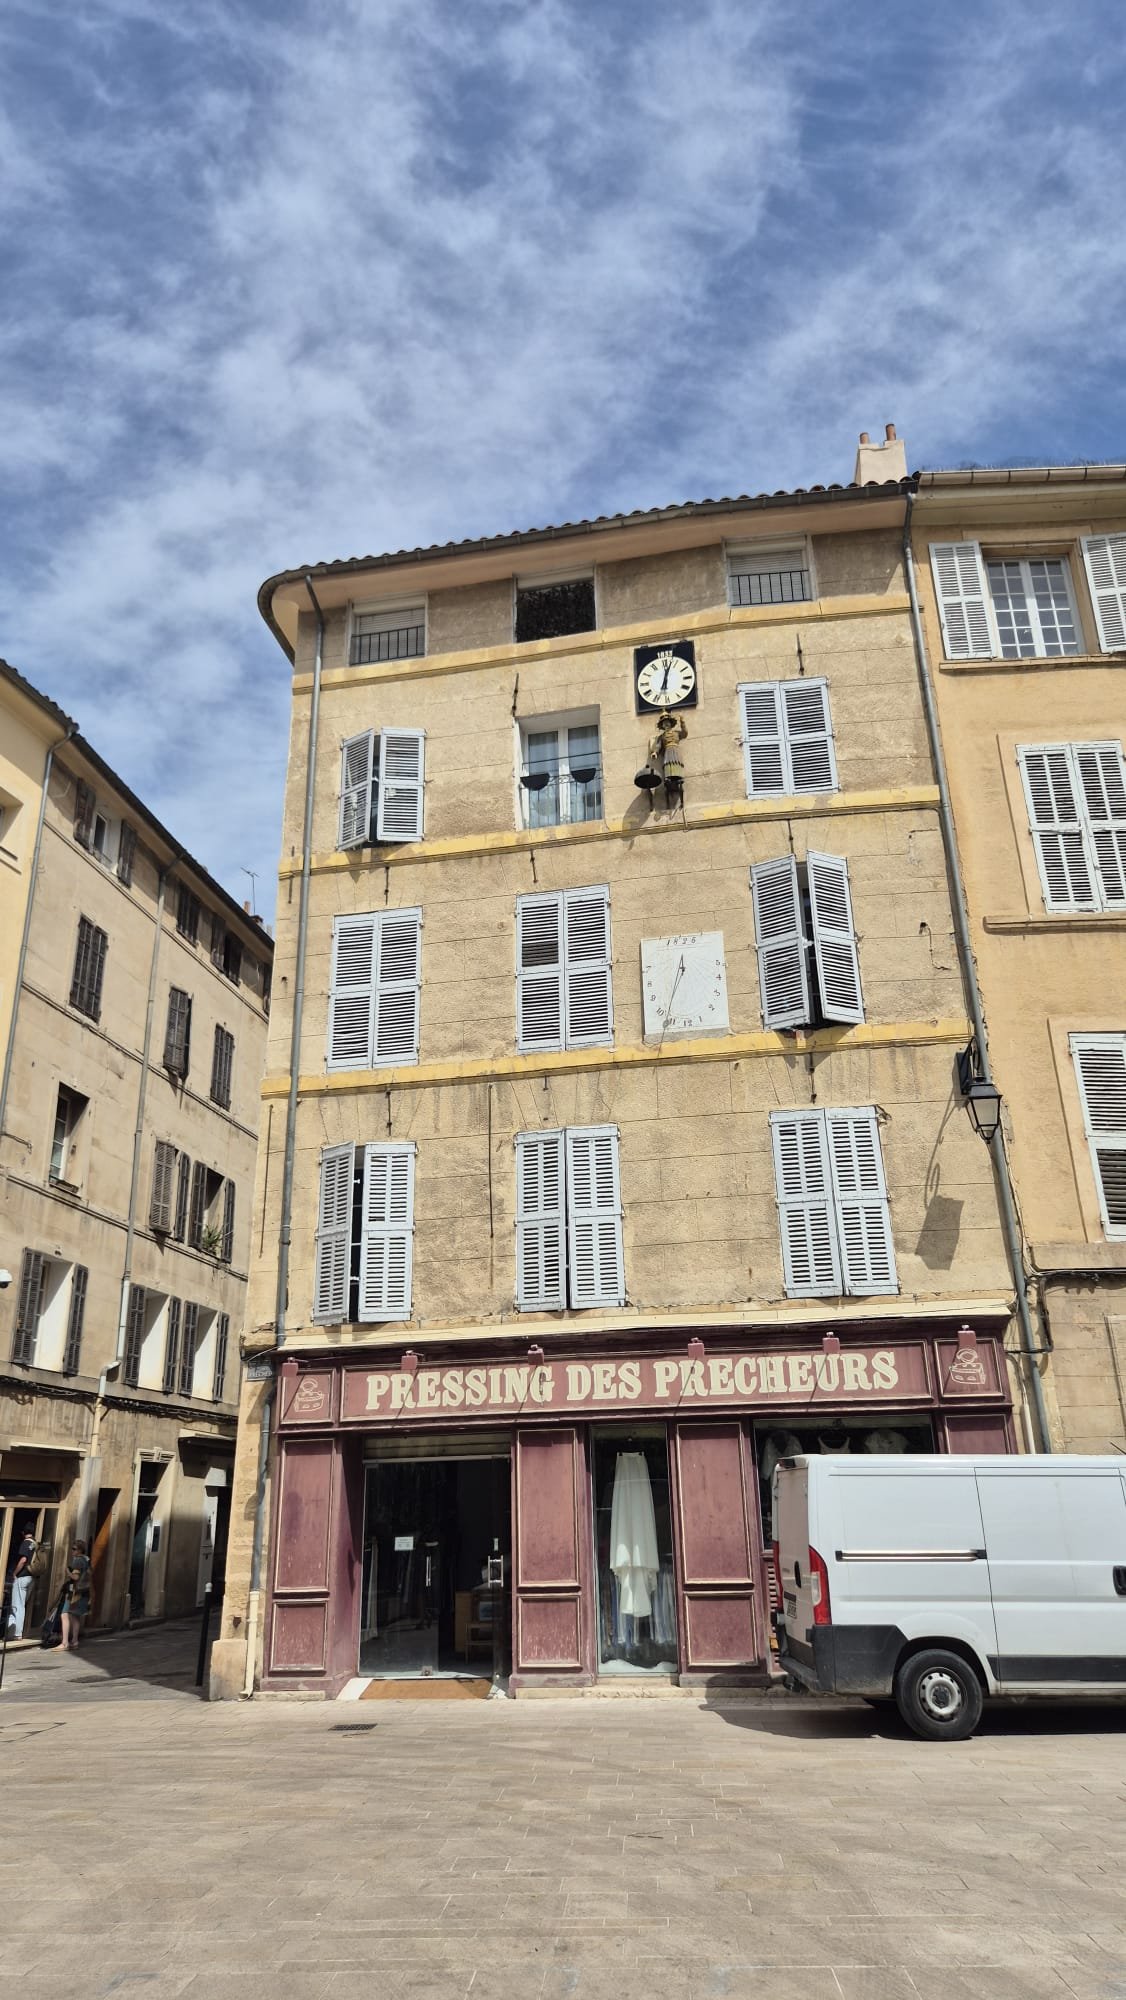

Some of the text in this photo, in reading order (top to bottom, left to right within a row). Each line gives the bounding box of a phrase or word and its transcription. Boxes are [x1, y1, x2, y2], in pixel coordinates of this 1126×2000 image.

[365, 1351, 898, 1410] PRESSING DES PRECHEURS
